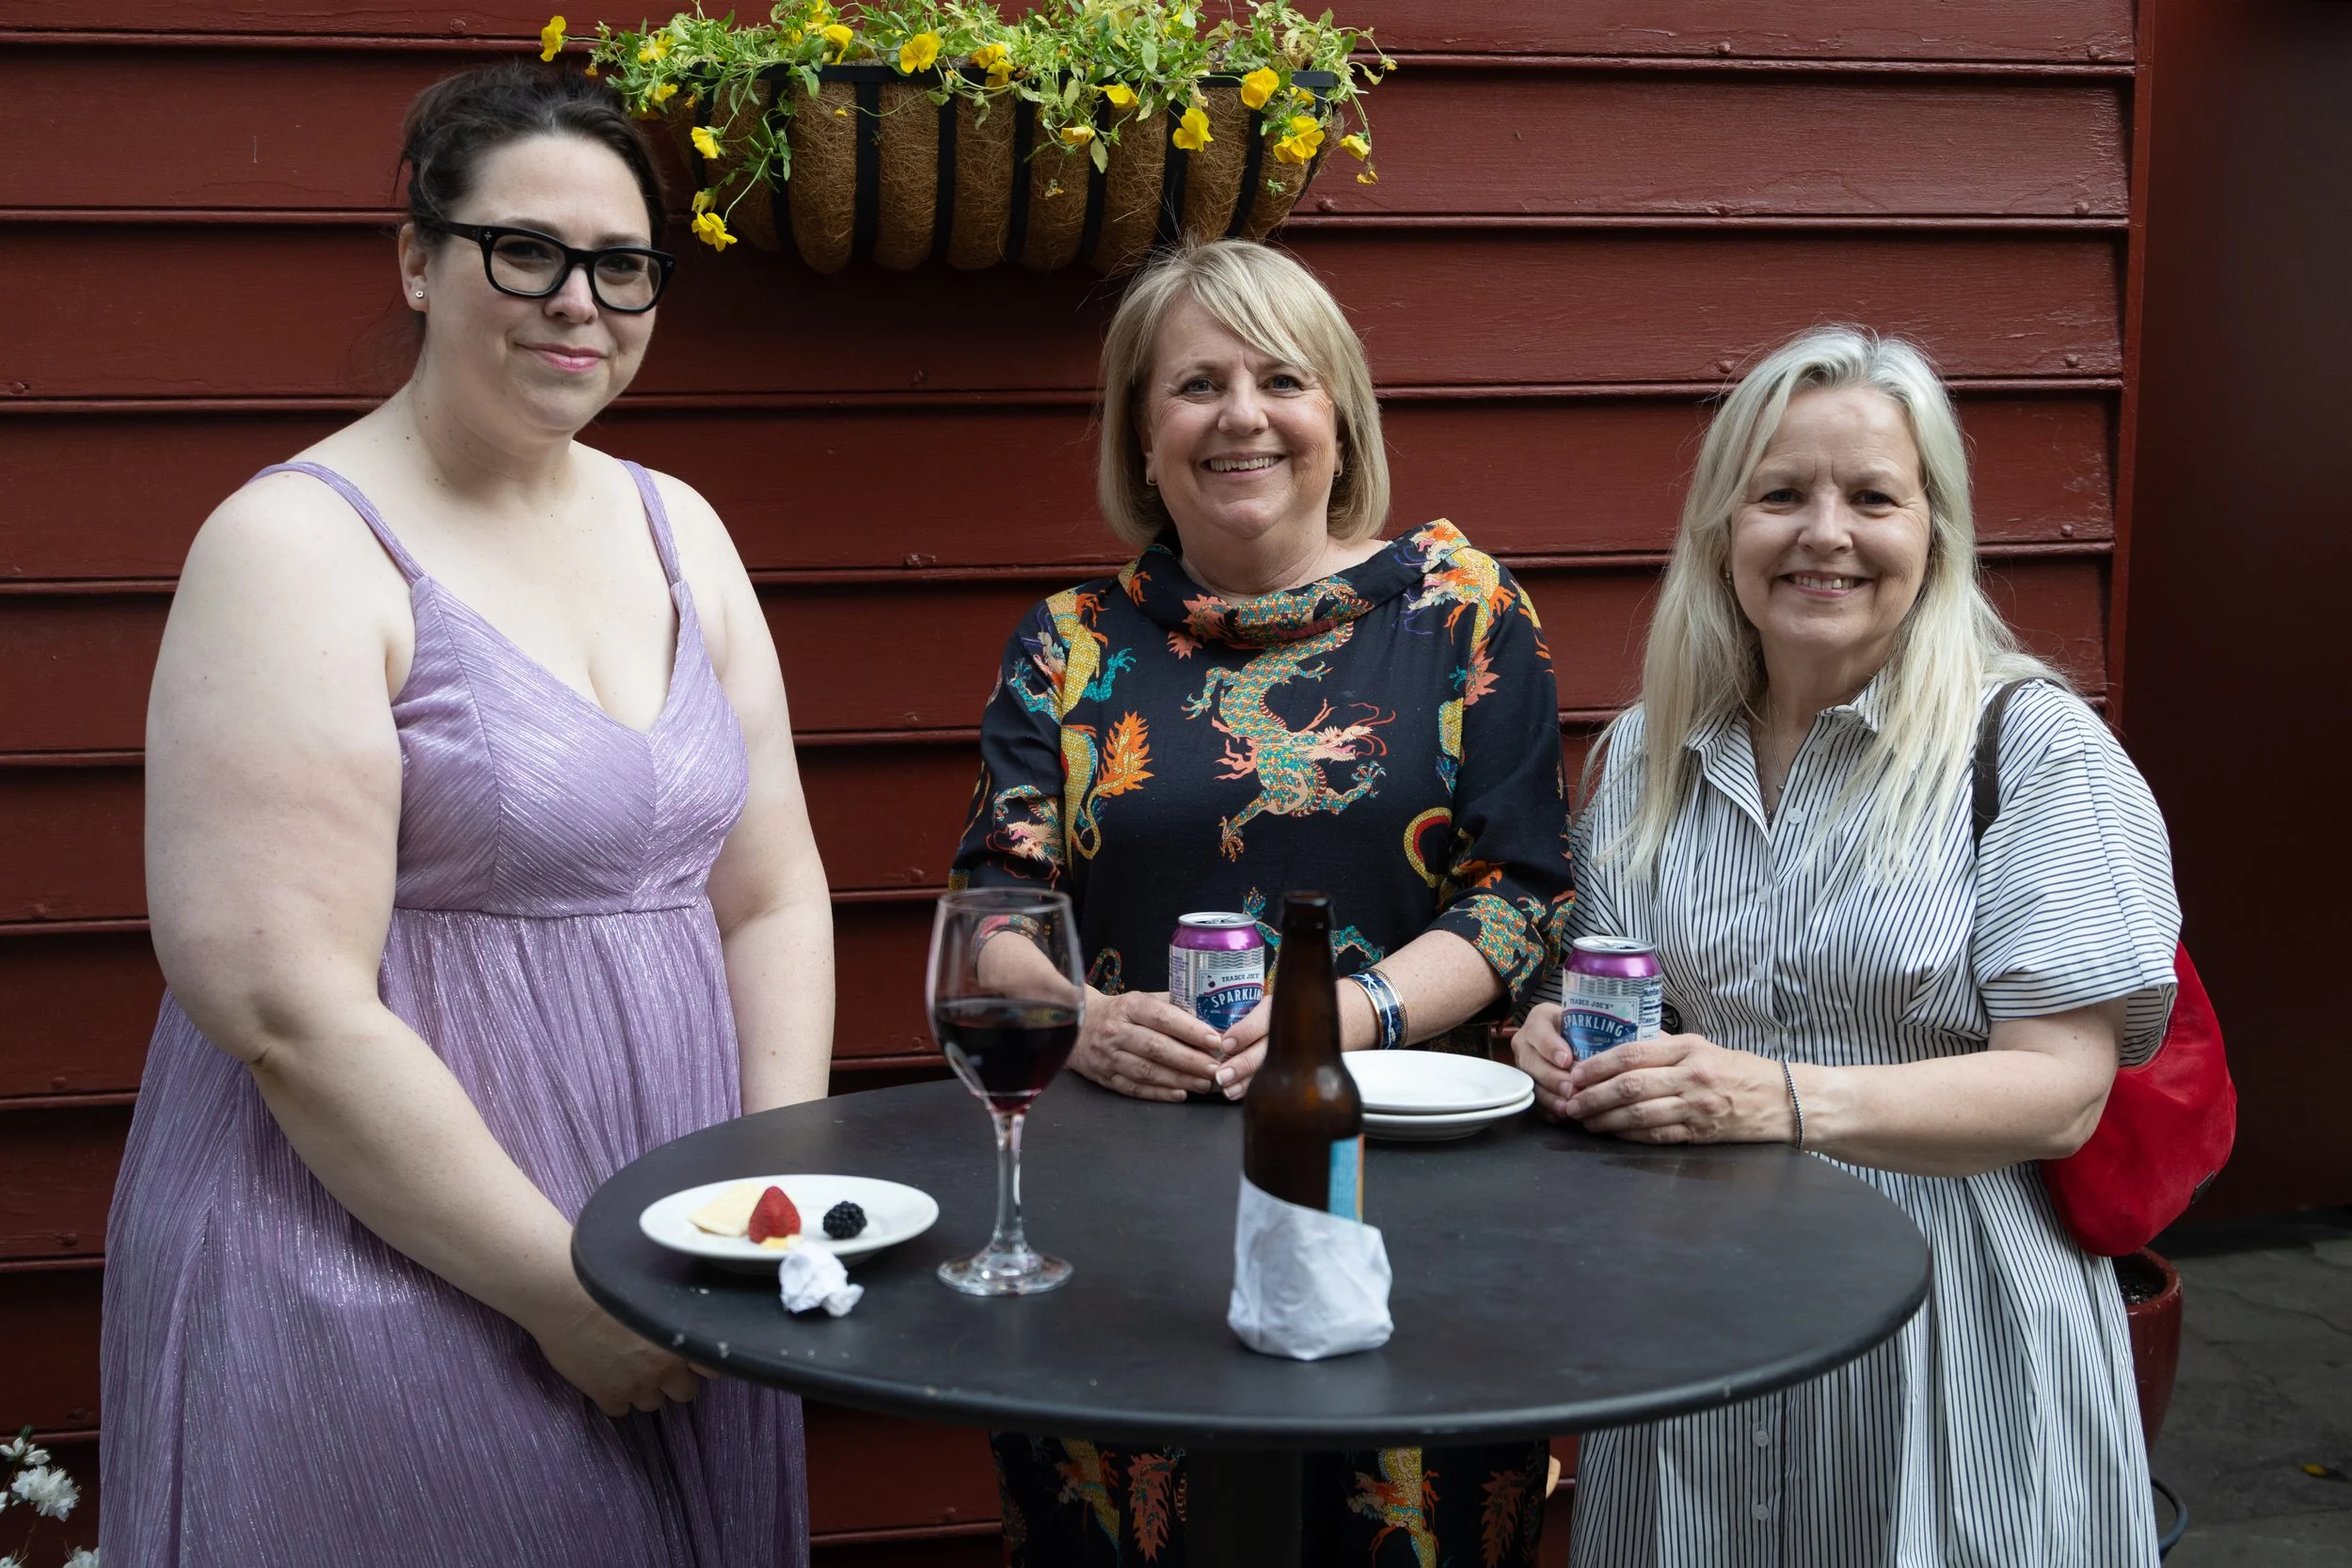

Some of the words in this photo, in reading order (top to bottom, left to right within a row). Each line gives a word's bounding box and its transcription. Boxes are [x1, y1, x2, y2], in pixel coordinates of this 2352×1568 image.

[1221, 974, 1246, 982] TRADER
[1569, 998, 1590, 1006] TRADER
[1564, 1014, 1624, 1037] SPARKLING
